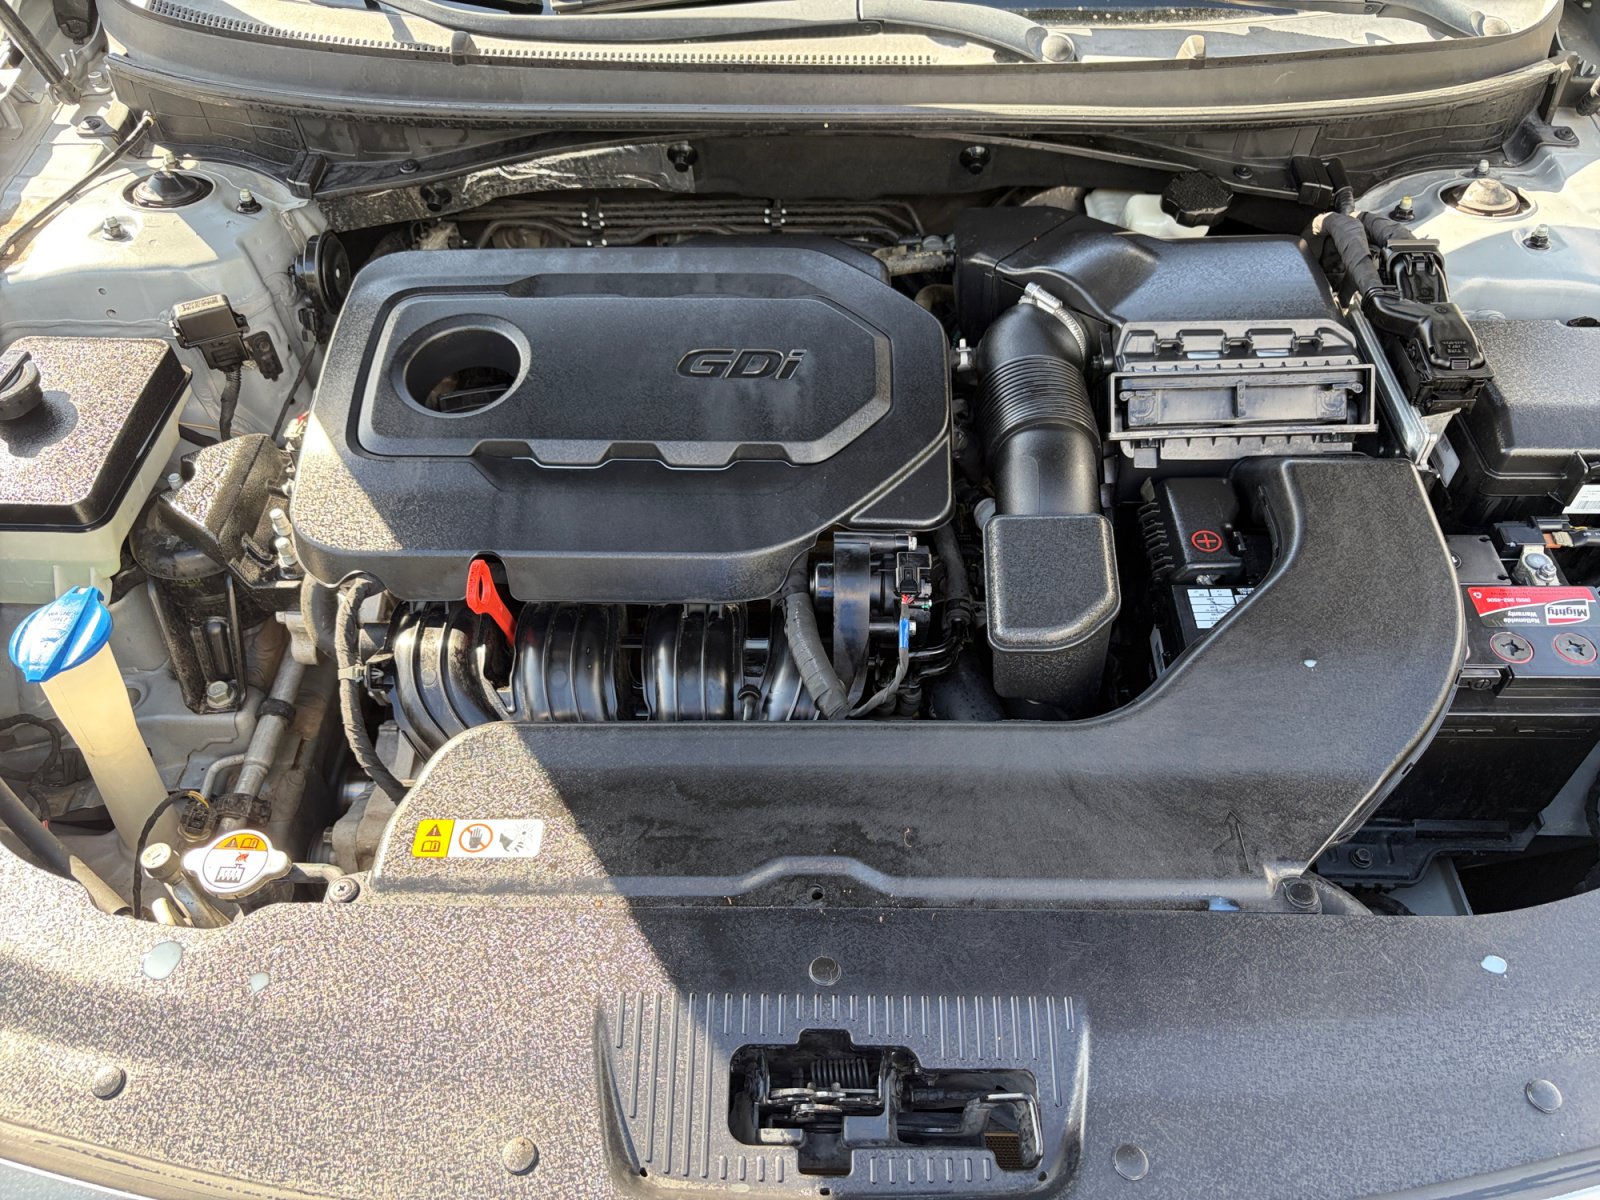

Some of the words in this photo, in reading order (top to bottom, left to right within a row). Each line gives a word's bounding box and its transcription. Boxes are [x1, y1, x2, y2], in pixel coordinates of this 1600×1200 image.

[675, 348, 807, 380] GDi
[1547, 607, 1587, 617] Mighty
[1503, 616, 1540, 624] Nationwide
